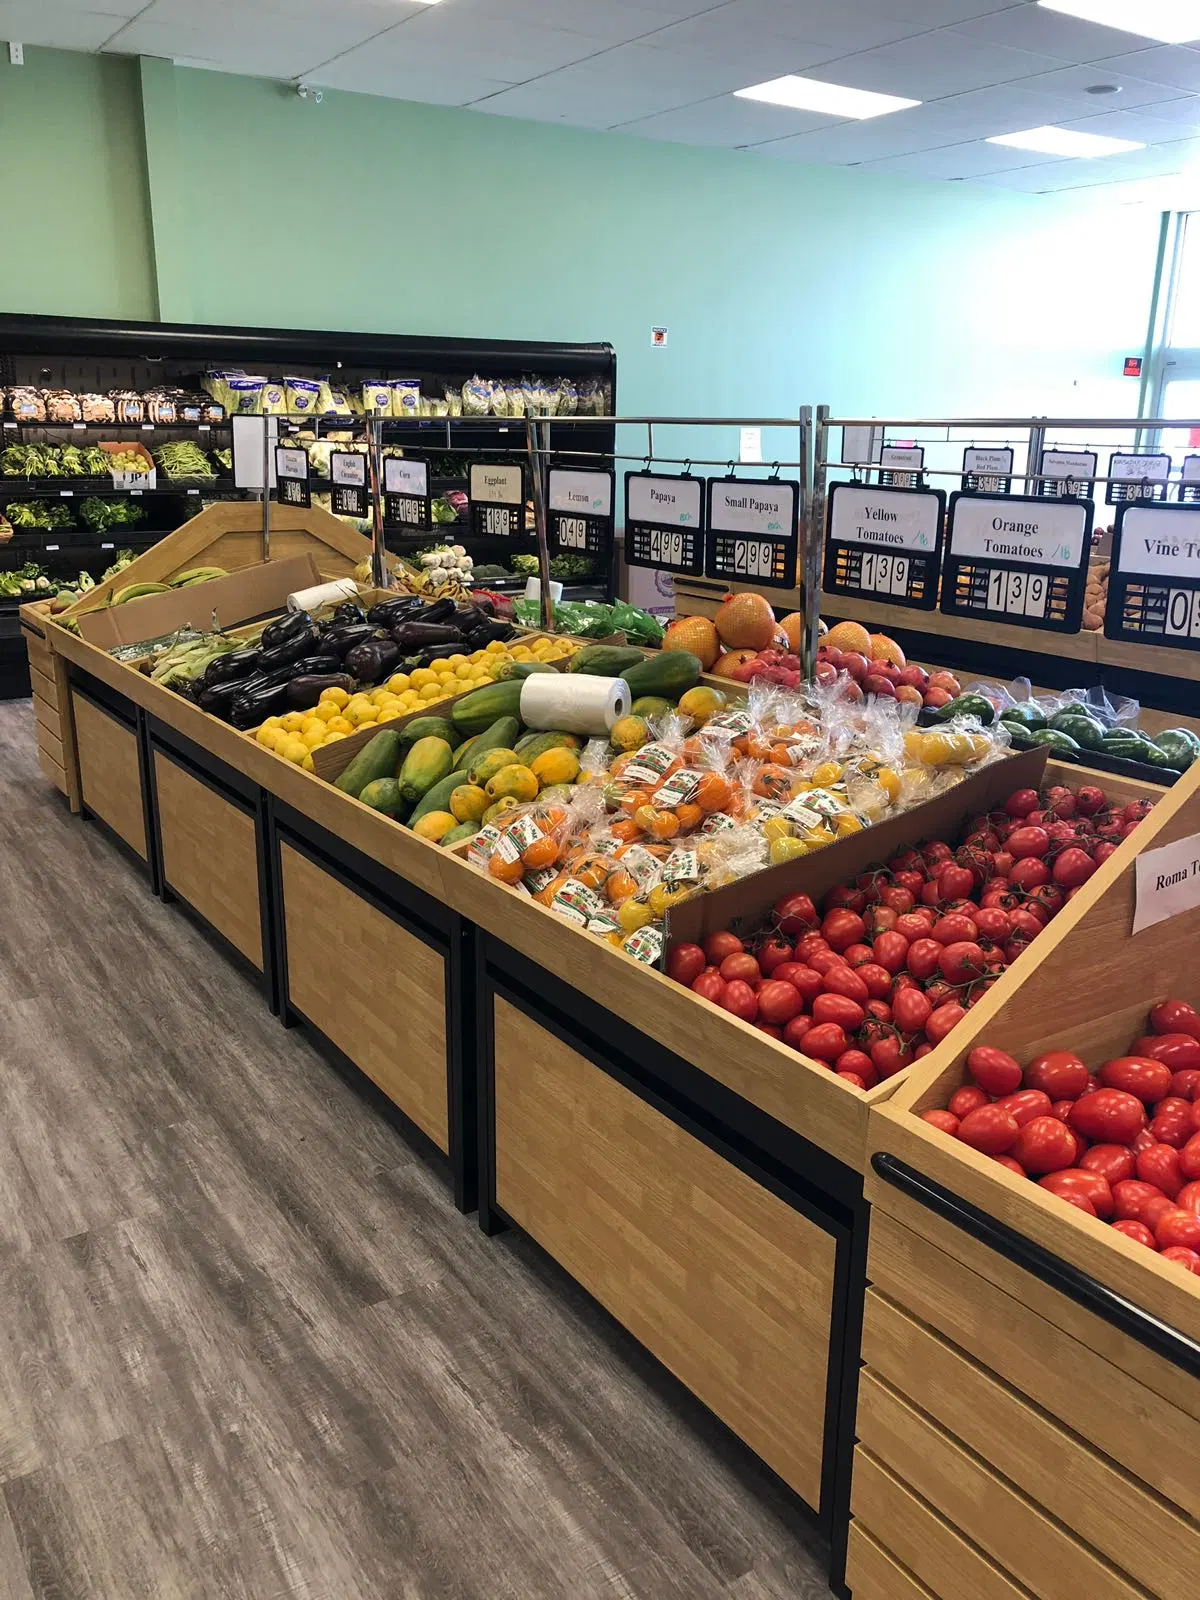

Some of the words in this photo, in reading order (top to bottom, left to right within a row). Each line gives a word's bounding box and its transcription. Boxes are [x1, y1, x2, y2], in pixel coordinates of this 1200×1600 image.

[484, 475, 507, 487] Eggplant
[568, 491, 589, 502] Lemon
[650, 488, 676, 505] Papaya
[724, 496, 748, 509] Small
[749, 498, 779, 515] Papaya
[865, 507, 898, 522] Yellow
[856, 526, 904, 544] Tomatoes
[992, 516, 1039, 537] Orange
[984, 538, 1044, 558] Tomatoes
[1144, 538, 1180, 556] Vine
[1184, 542, 1200, 559] T
[1155, 868, 1188, 891] Roma
[1190, 859, 1200, 876] T
